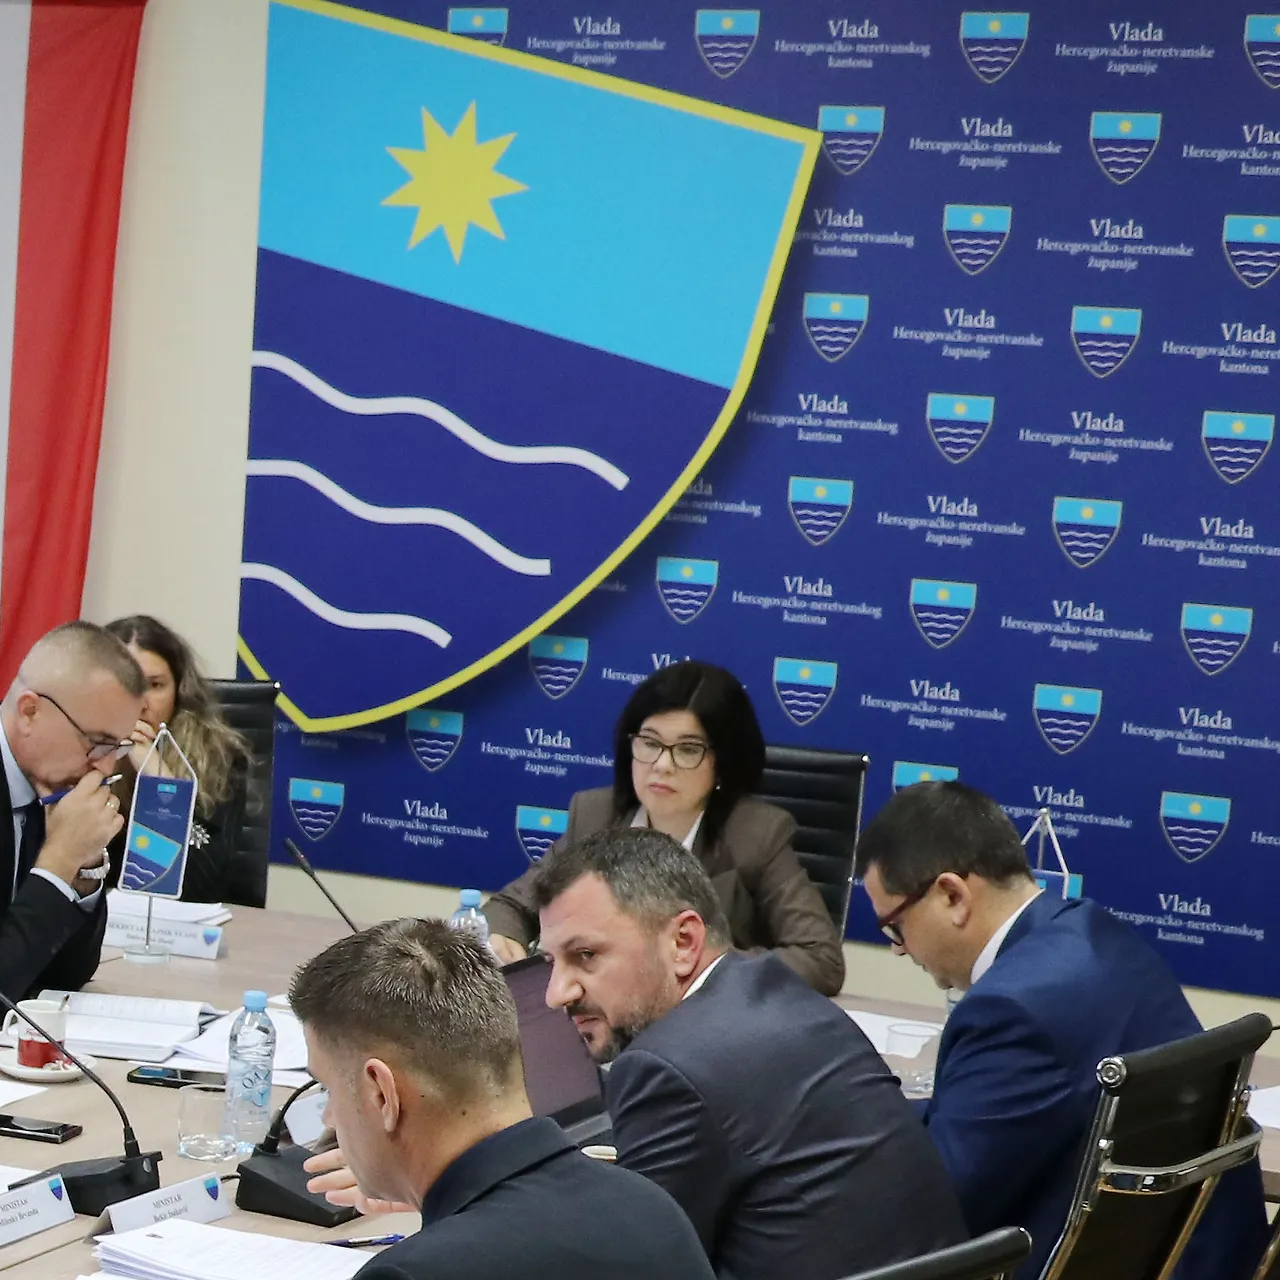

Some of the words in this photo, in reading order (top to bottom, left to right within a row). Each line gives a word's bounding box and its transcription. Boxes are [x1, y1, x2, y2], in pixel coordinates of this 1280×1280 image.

[573, 16, 621, 35] Vlada
[828, 19, 879, 39] Vlada
[1109, 22, 1164, 42] Vlada
[961, 118, 1013, 138] Vlada
[814, 208, 865, 229] Vlada
[1090, 218, 1144, 239] Vlada
[944, 308, 996, 329] Vlada
[1221, 323, 1277, 345] Vlada
[1220, 359, 1270, 375] kantona
[798, 394, 849, 415] Vlada
[1071, 411, 1125, 432] Vlada
[798, 427, 843, 443] kantona
[685, 478, 713, 495] ada
[927, 495, 979, 517] Vlada
[1200, 517, 1255, 539] Vlada
[1198, 553, 1248, 569] kantona
[784, 576, 833, 598] Vlada
[783, 610, 827, 626] kantona
[1052, 600, 1105, 622] Vlada
[910, 679, 961, 702] Vlada
[1179, 707, 1233, 730] Vlada
[526, 728, 572, 750] Vlada
[1177, 743, 1226, 760] kantona
[1033, 786, 1085, 809] Vlada
[404, 800, 449, 821] Vlada
[1159, 894, 1212, 917] Vlada
[1157, 928, 1205, 946] kantona
